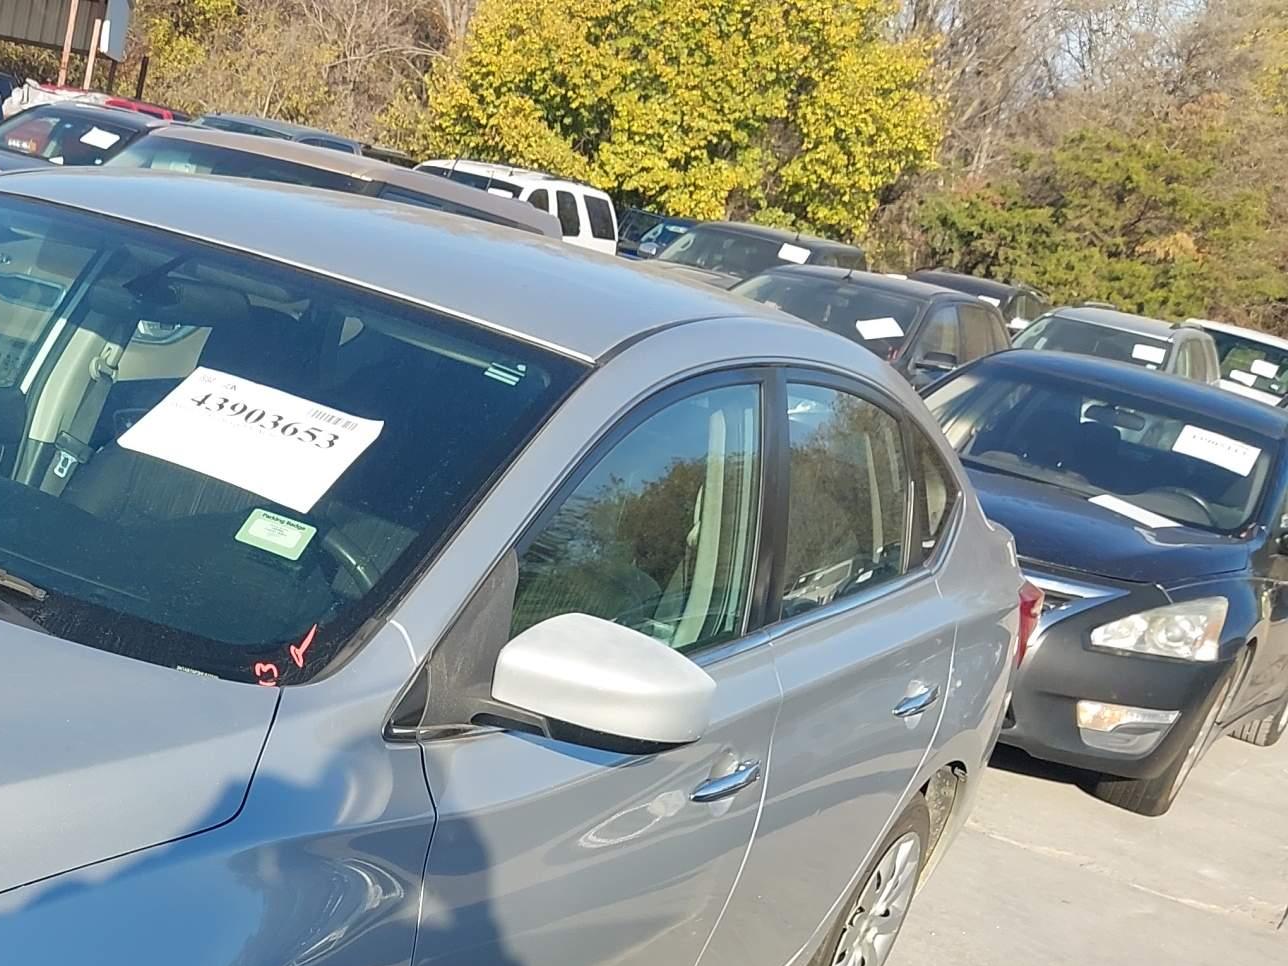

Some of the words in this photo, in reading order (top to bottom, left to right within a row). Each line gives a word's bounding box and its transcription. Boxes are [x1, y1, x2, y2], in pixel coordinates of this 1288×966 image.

[190, 392, 340, 449] 43903653
[262, 512, 286, 525] Parking
[286, 520, 307, 531] Badge
